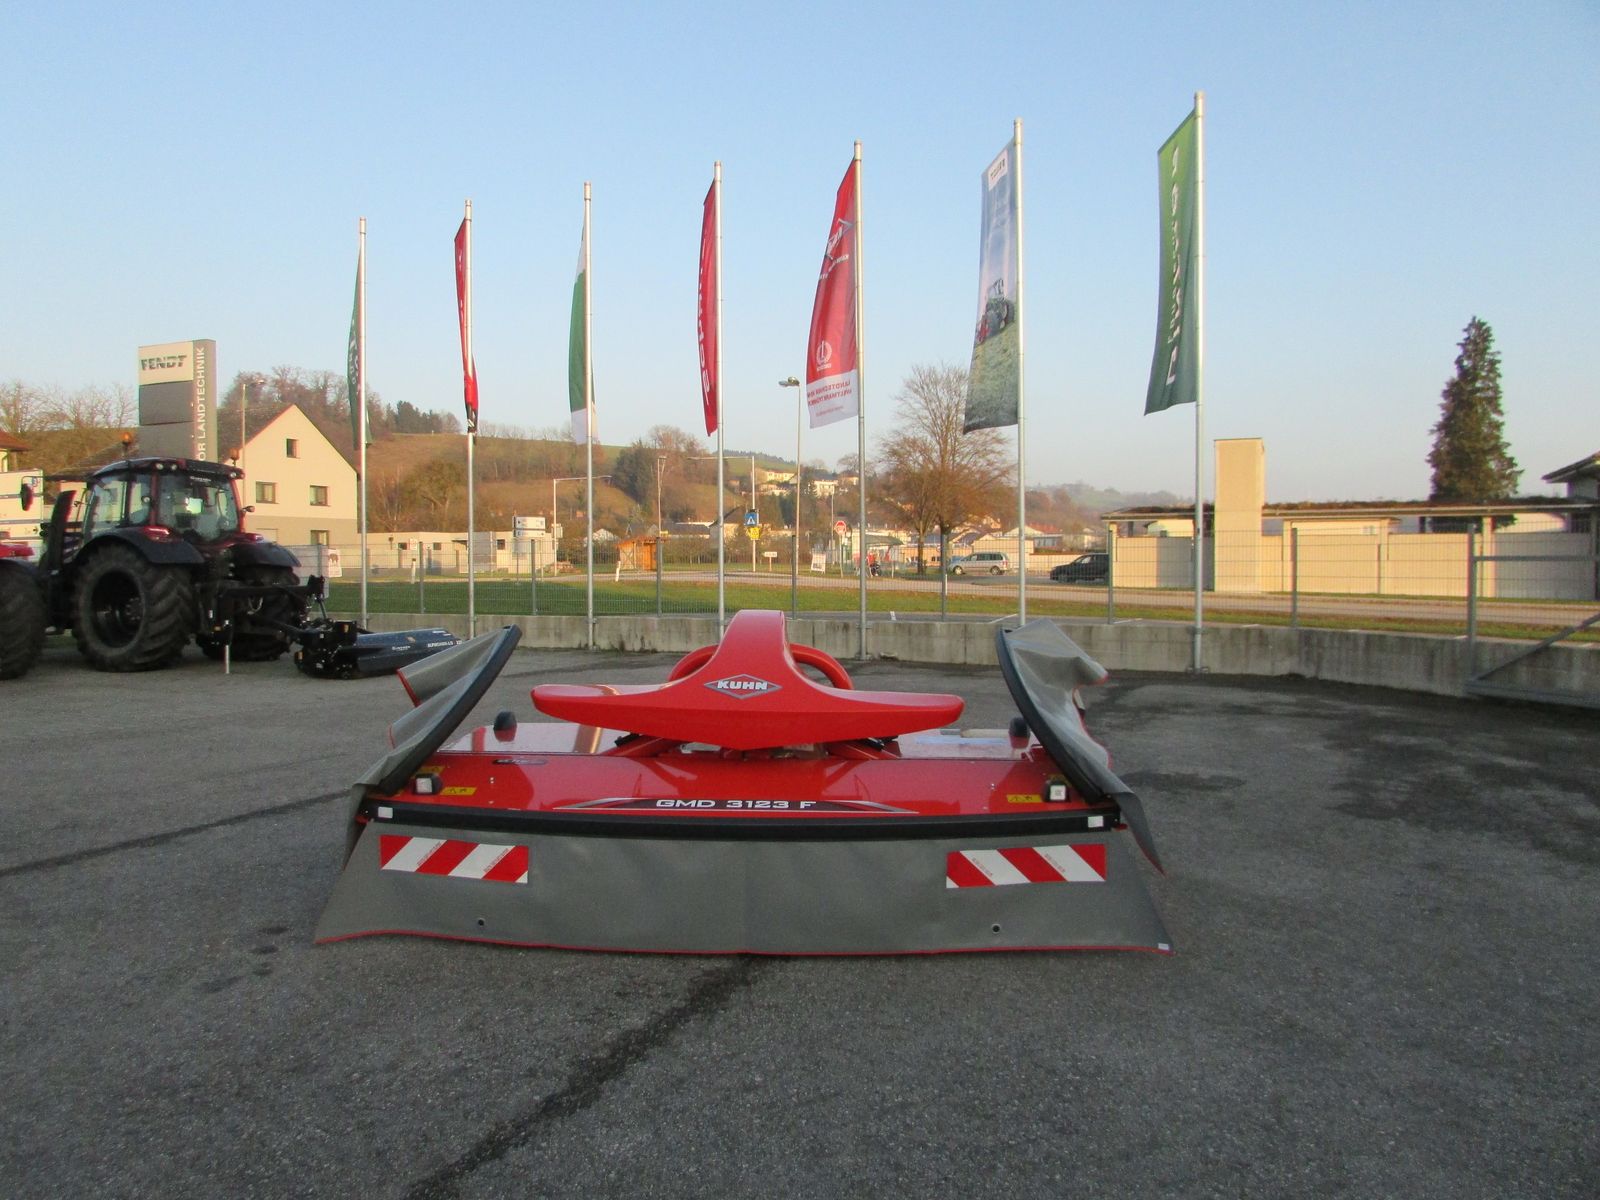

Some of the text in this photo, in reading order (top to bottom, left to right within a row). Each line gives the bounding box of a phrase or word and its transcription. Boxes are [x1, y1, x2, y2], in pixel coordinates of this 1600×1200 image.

[141, 355, 187, 370] FENDT
[196, 347, 206, 439] LANDTECHNIK
[717, 680, 768, 690] KUHN
[656, 799, 817, 809] GMD 3123 F
